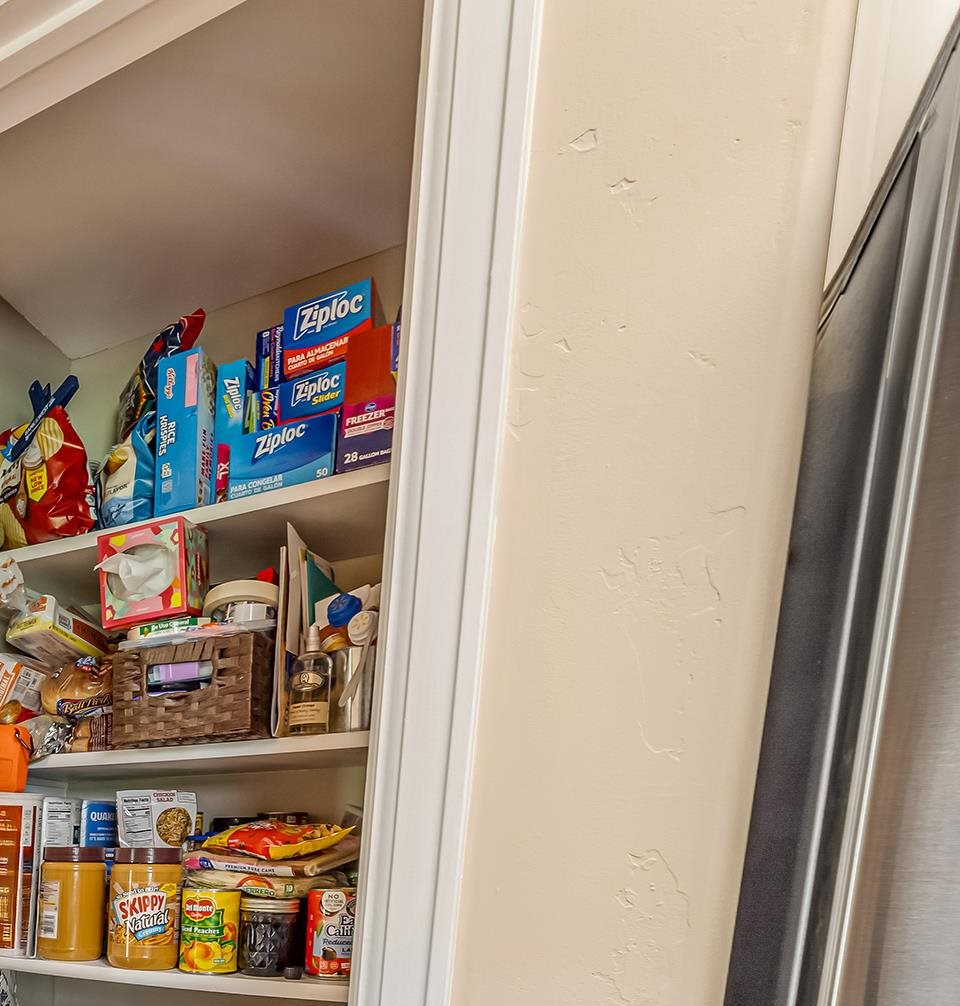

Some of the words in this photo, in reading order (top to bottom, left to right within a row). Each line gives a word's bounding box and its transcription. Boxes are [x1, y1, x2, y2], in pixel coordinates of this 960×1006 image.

[300, 294, 364, 333] Ziploc
[287, 352, 306, 366] PARA
[306, 336, 349, 358] ALMACENAR
[223, 376, 242, 410] Ziploc
[296, 374, 340, 402] Ziploc
[311, 390, 342, 405] Slider
[345, 409, 386, 426] FREEZER
[158, 415, 167, 457] KRISPIES
[167, 420, 176, 445] RICE
[254, 423, 306, 459] Ziploc
[343, 452, 358, 464] 28
[358, 451, 380, 461] GALLON
[217, 461, 230, 481] XL
[315, 467, 328, 478] 50
[230, 481, 247, 494] PARA
[247, 473, 283, 489] CONGELAR
[64, 698, 85, 714] Ball
[90, 811, 117, 822] QUAKE
[119, 894, 165, 920] SKIPPY
[125, 909, 170, 935] Natural
[138, 926, 163, 938] Creamy
[193, 926, 220, 935] Peaches
[322, 938, 354, 947] Reduce
